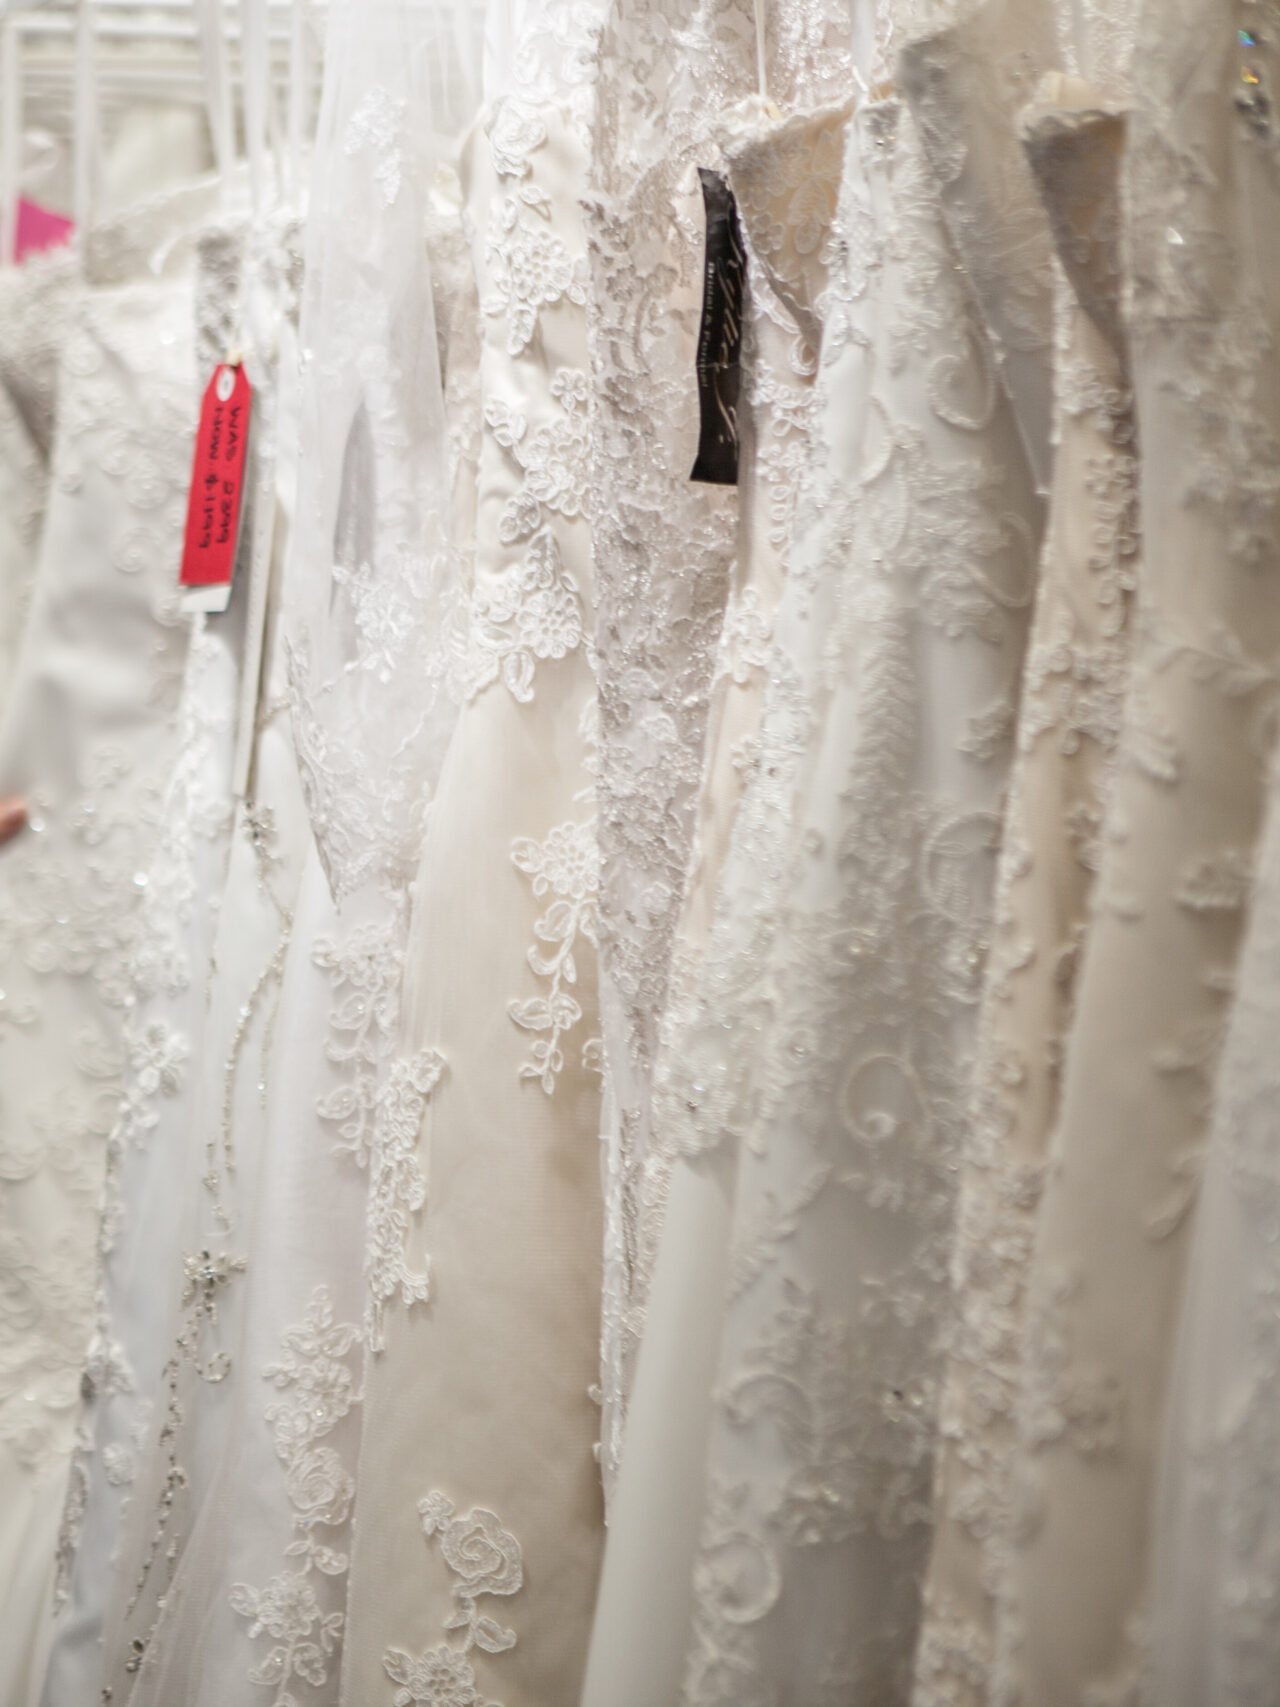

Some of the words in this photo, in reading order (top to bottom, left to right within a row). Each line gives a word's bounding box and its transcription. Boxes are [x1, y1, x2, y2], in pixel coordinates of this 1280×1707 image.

[705, 261, 715, 310] Bridal
[698, 330, 711, 388] Formal
[208, 406, 224, 461] NOW
[225, 405, 242, 462] WAS
[198, 473, 220, 549] $1199
[216, 480, 235, 544] 2399
